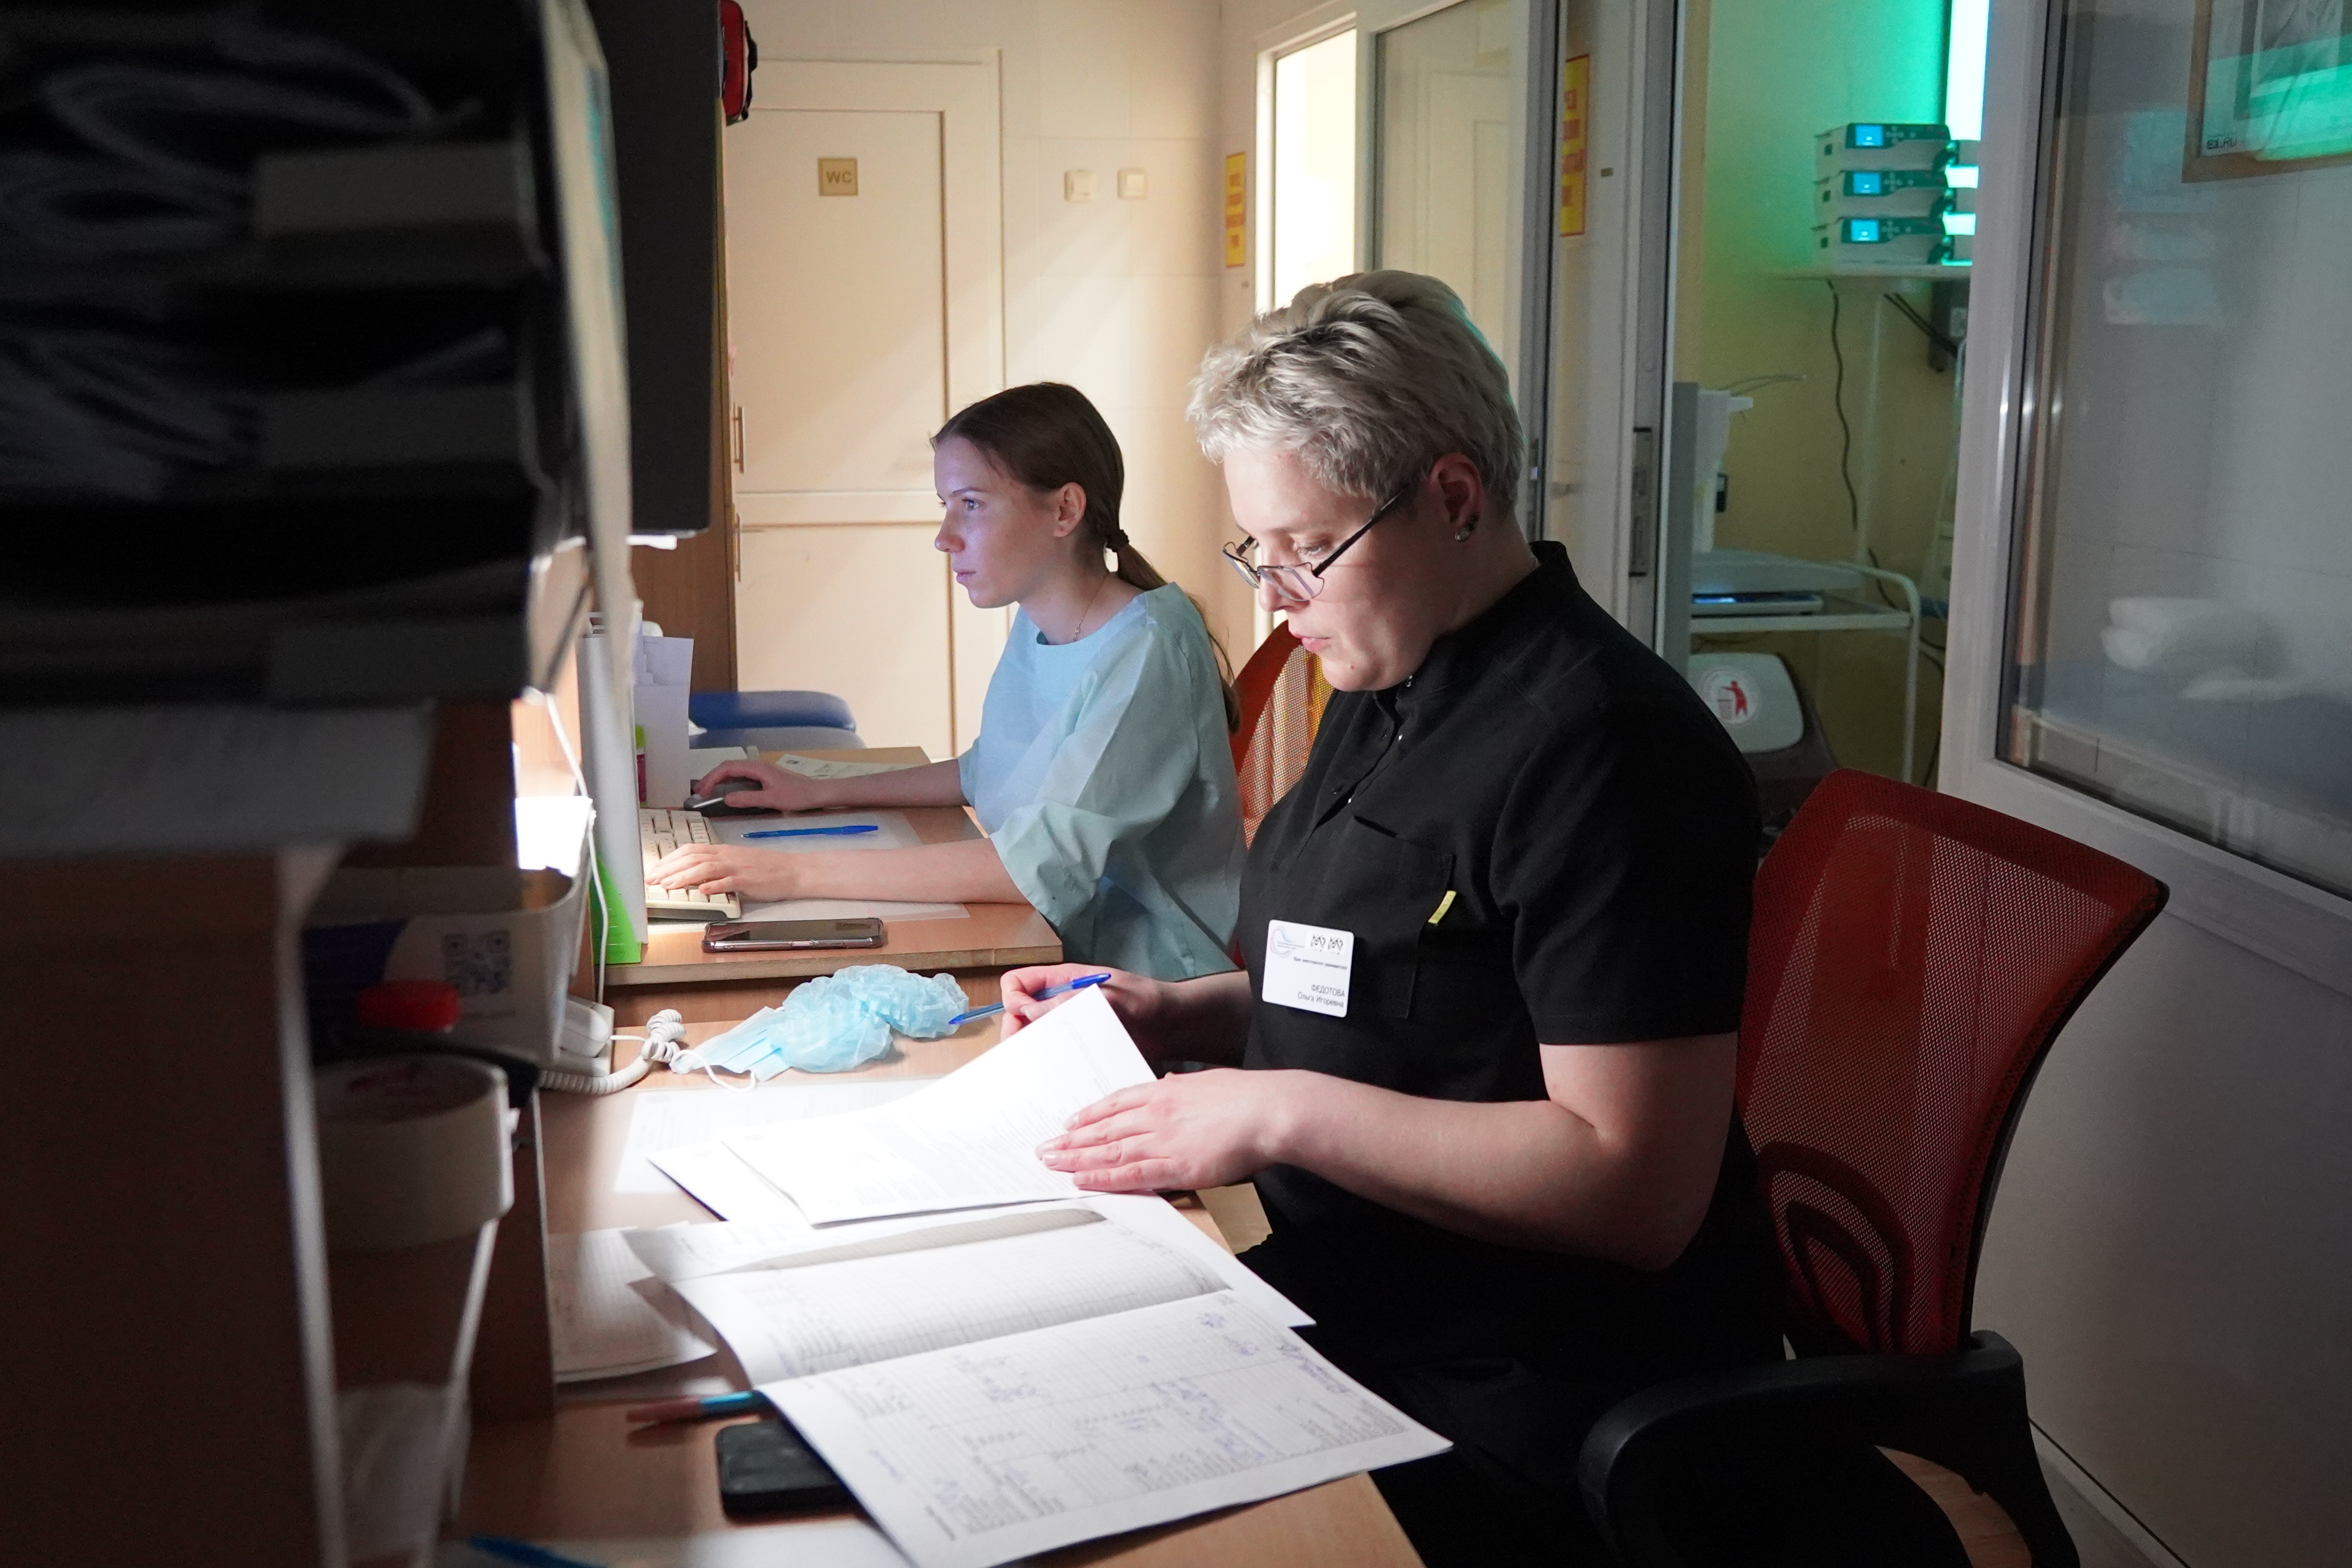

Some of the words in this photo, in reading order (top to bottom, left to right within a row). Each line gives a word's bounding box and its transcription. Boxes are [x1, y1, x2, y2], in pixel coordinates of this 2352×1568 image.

[826, 171, 852, 183] WC
[1311, 984, 1345, 997] ФЕДОТОВА
[1298, 991, 1315, 1002] Ольга
[1316, 996, 1344, 1007] Игоревна
